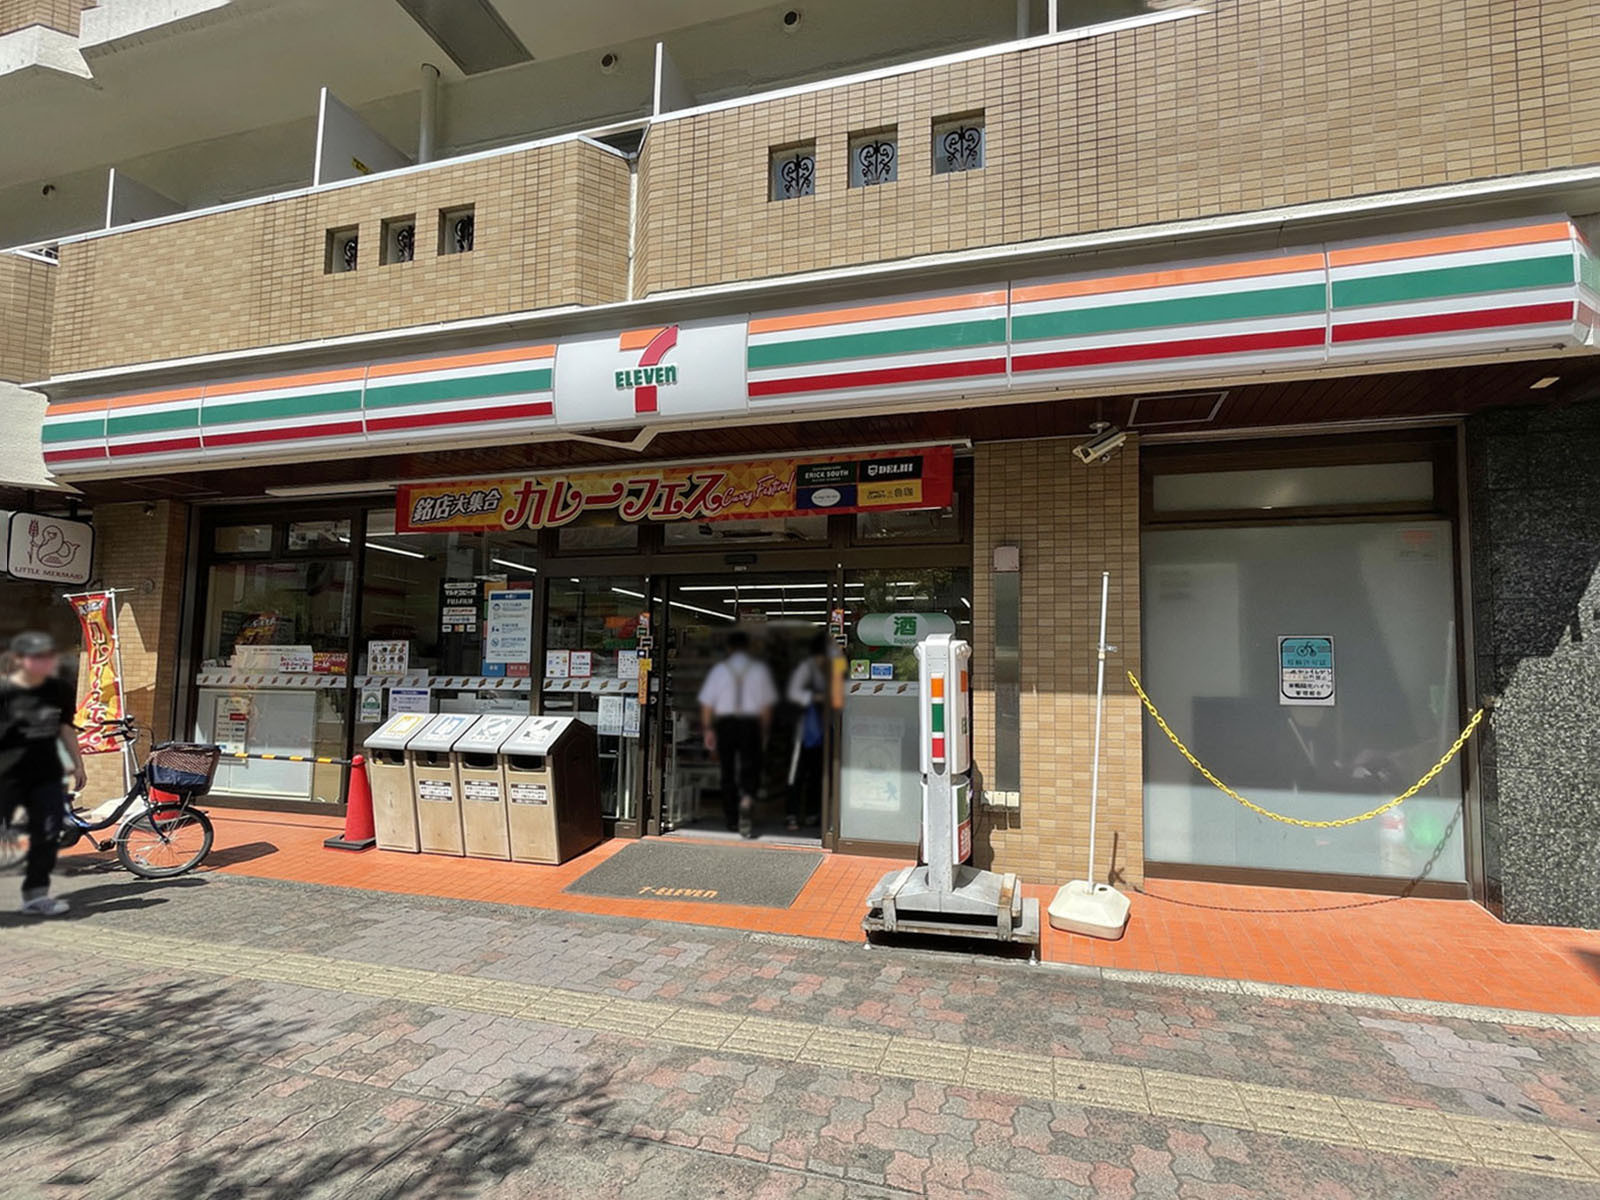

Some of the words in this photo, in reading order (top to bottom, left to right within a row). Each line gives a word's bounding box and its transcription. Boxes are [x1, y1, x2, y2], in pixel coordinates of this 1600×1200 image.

[804, 471, 825, 479] ERICK
[826, 469, 849, 478] SOUTH
[878, 462, 914, 475] DELHI
[411, 488, 501, 523] 銘店大集合
[503, 471, 725, 527] カレーフェス
[721, 487, 754, 507] Curry
[14, 566, 41, 576] LITTLE
[42, 569, 84, 581] MERMAID
[893, 616, 918, 636] 酒
